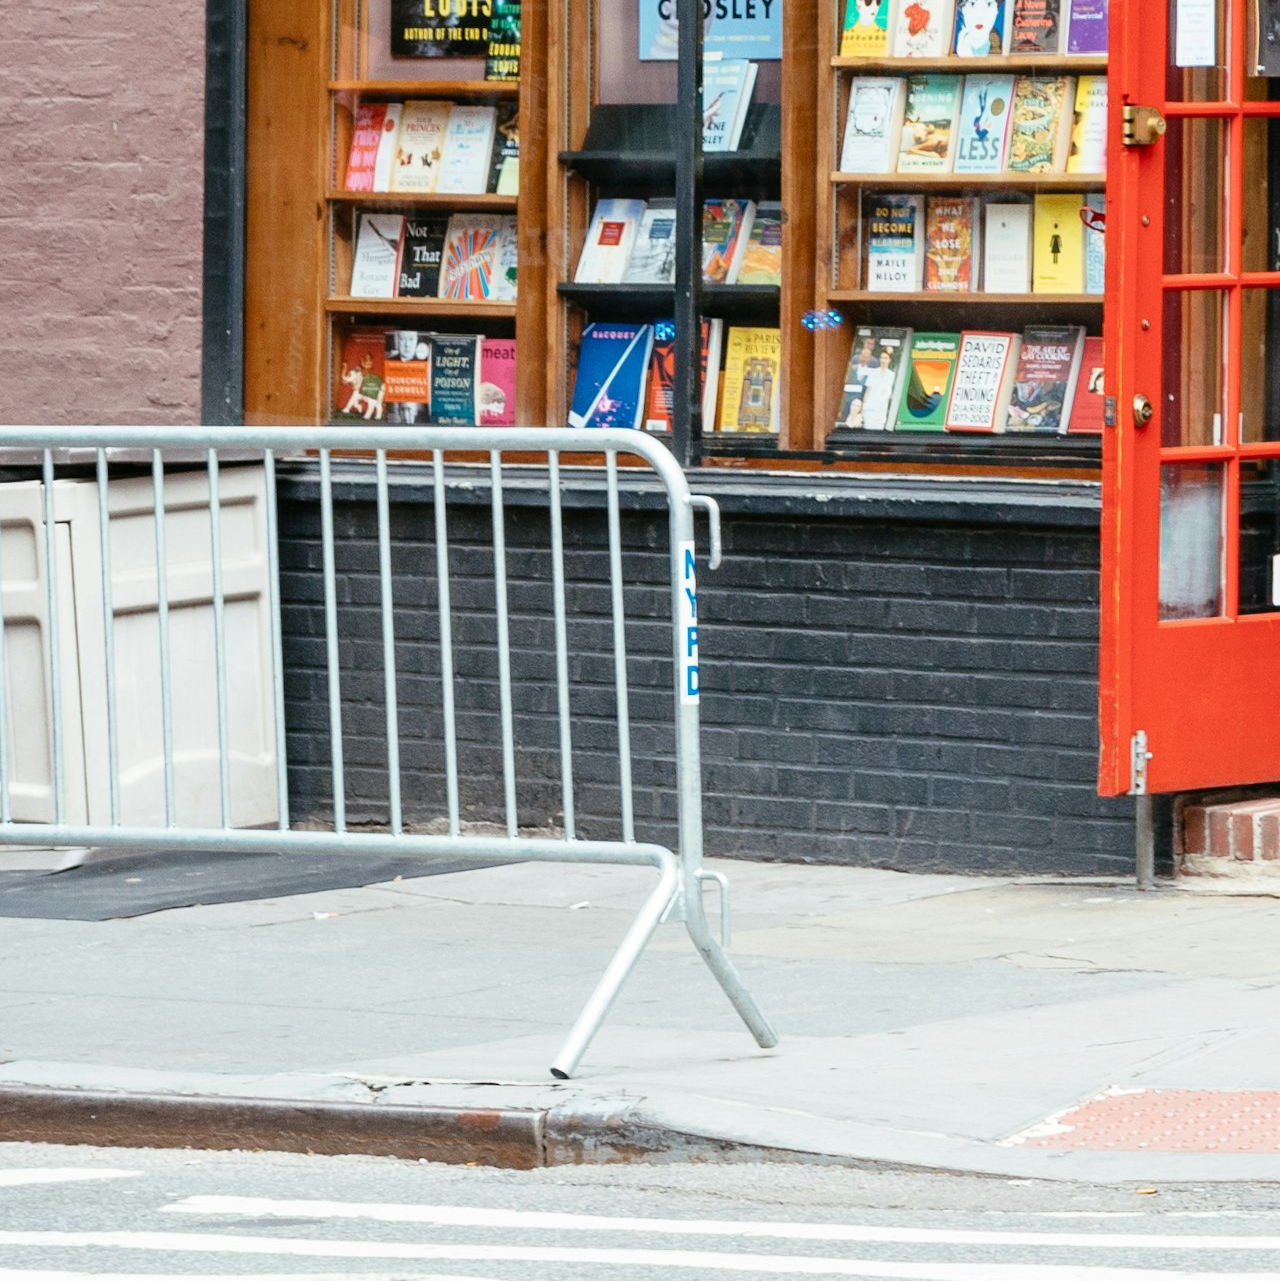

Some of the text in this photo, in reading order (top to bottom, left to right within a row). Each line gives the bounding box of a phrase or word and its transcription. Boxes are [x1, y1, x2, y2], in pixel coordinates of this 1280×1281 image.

[404, 27, 434, 41] AUTHOR
[435, 27, 446, 40] OF
[448, 27, 463, 41] THE
[464, 27, 481, 40] END
[405, 123, 441, 134] PRINCES
[957, 137, 1000, 161] LESS
[935, 206, 963, 216] WHAT
[405, 222, 428, 238] Not
[872, 222, 913, 233] BECOME
[941, 222, 956, 233] WE
[934, 238, 961, 249] LOSE
[413, 245, 441, 263] That
[876, 259, 907, 268] MAILE
[400, 271, 422, 289] Bad
[591, 330, 636, 340] RACQUET
[481, 347, 516, 361] meat
[964, 340, 1005, 354] DAVID
[961, 354, 1002, 369] SEDARIS
[385, 376, 428, 386] CHURCHILL
[433, 376, 471, 389] POISON
[960, 370, 992, 385] THEFT
[955, 387, 995, 402] FINDING
